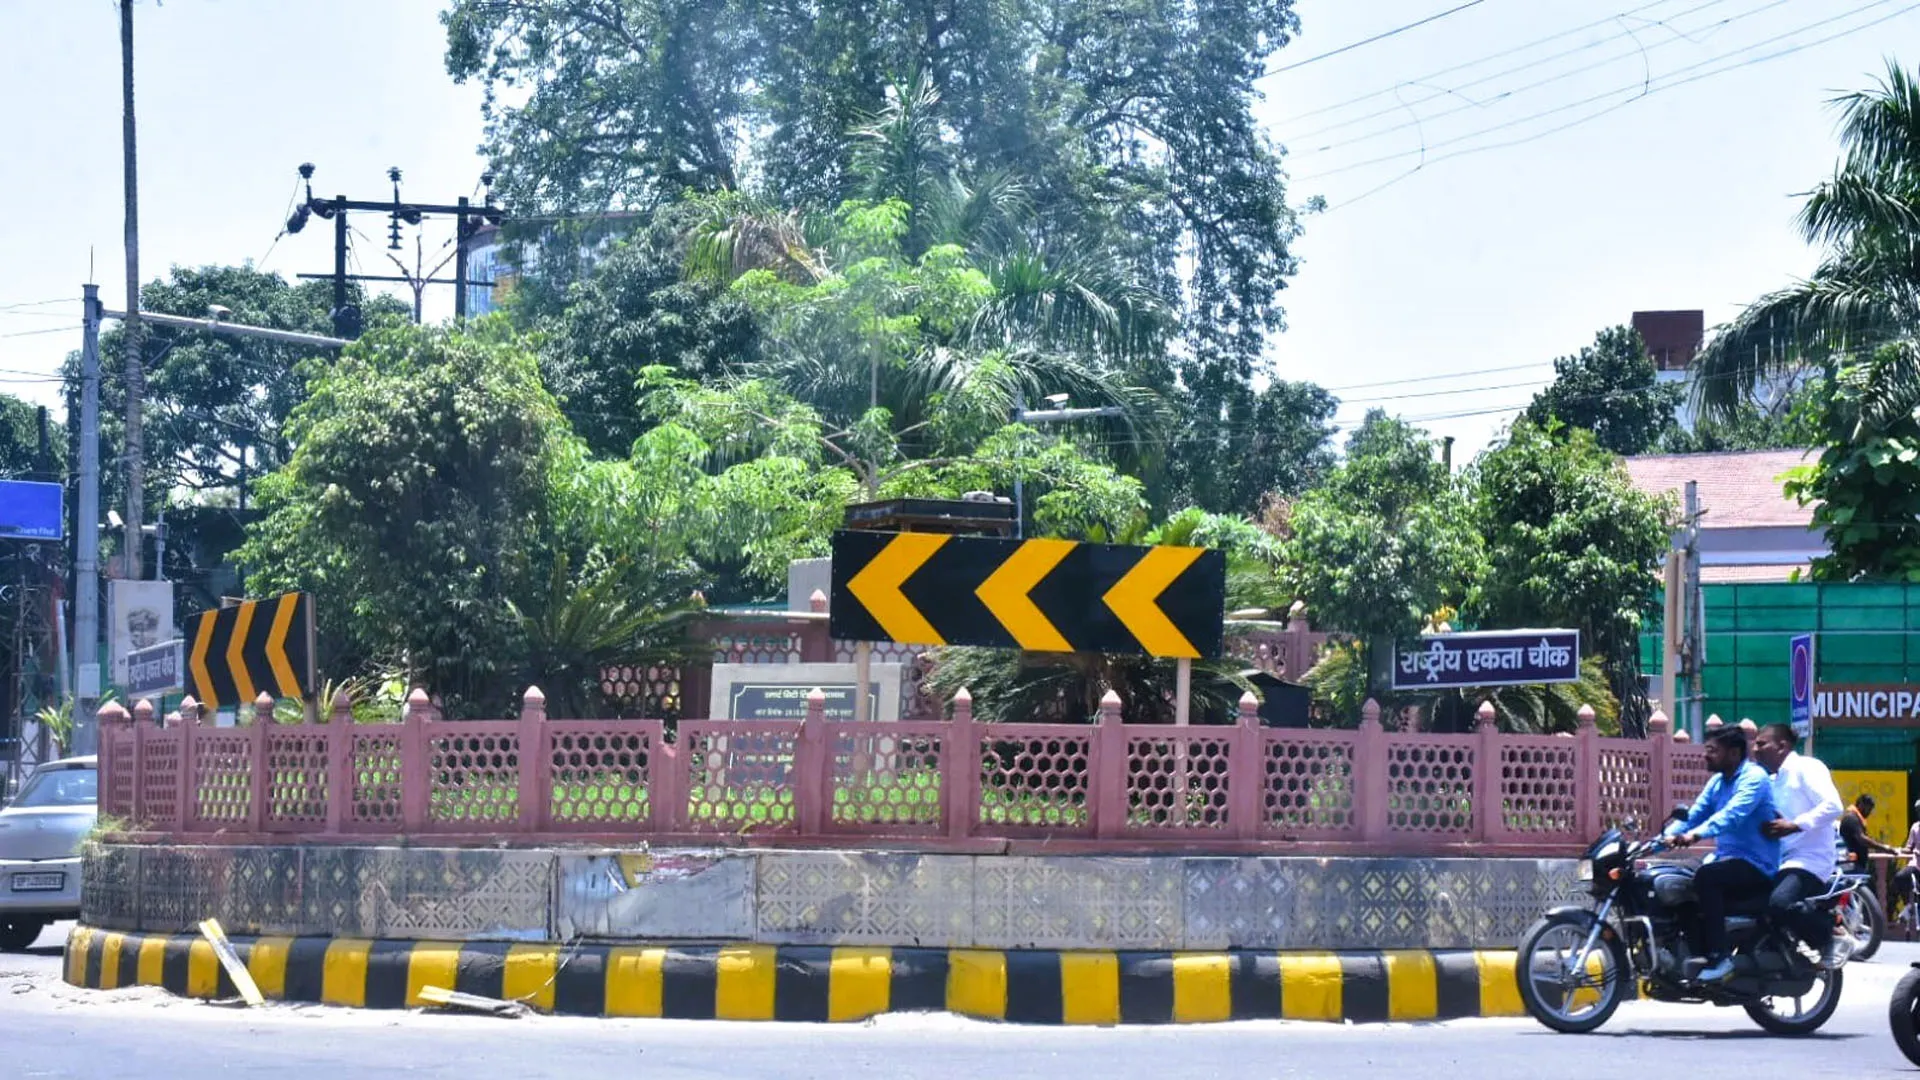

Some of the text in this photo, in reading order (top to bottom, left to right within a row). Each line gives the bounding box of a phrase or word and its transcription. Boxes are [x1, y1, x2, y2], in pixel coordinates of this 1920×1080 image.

[1400, 638, 1571, 682] राष्ट्रीय एकता चौक
